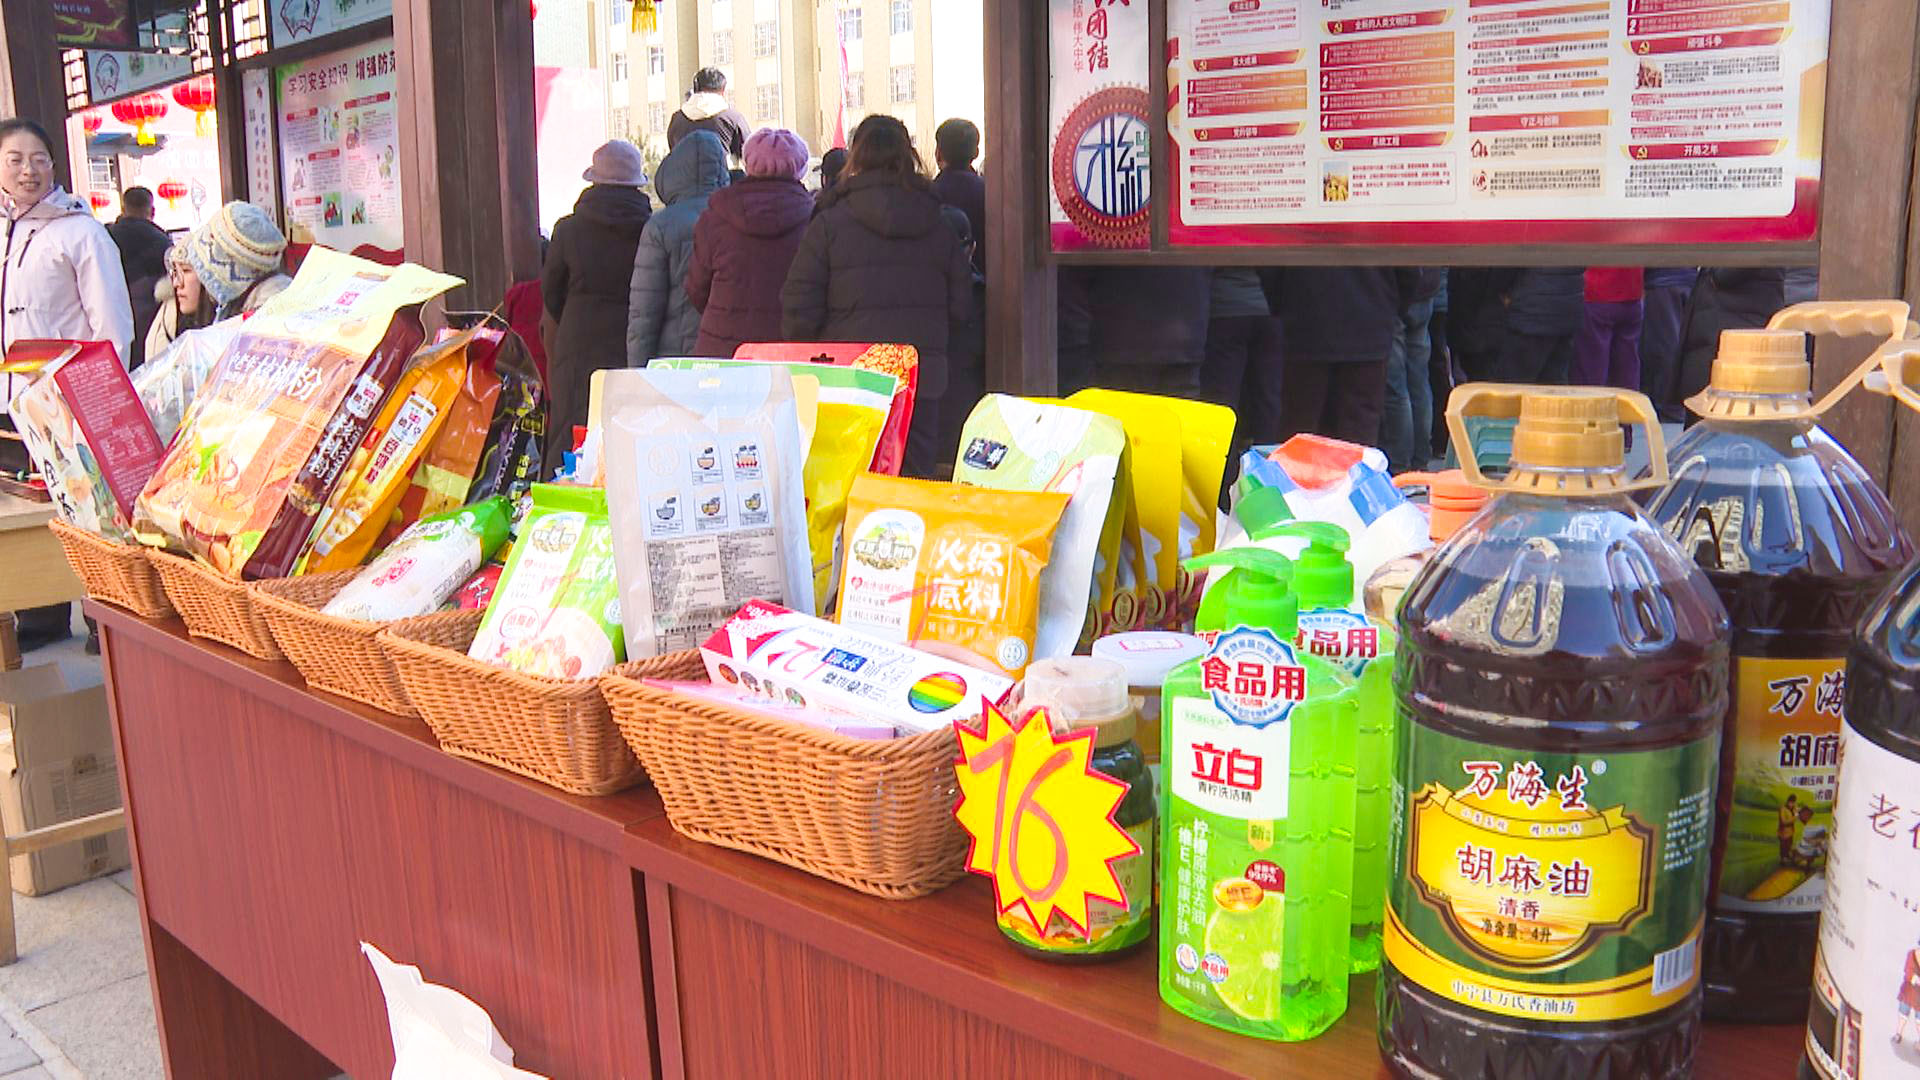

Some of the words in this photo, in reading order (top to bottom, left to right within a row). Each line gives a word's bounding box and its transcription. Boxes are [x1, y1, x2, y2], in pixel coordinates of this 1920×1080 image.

[1087, 0, 1130, 74] 团结
[1629, 19, 1637, 33] 2
[288, 63, 348, 96] 学习安全知识
[1322, 75, 1328, 89] 2
[1188, 103, 1194, 115] 2
[1322, 96, 1328, 109] 3
[1322, 115, 1328, 128] 4
[935, 537, 1004, 577] 火锅
[931, 575, 1003, 621] 底料
[1201, 656, 1305, 701] 食品用
[1191, 741, 1263, 791] 立白
[1198, 780, 1253, 804] 青柠洗洁精
[1459, 760, 1588, 811] 万海生
[1457, 844, 1591, 896] 胡麻油
[1499, 896, 1540, 920] 清香
[1451, 980, 1576, 1015] 中宁县万氏香油坊
